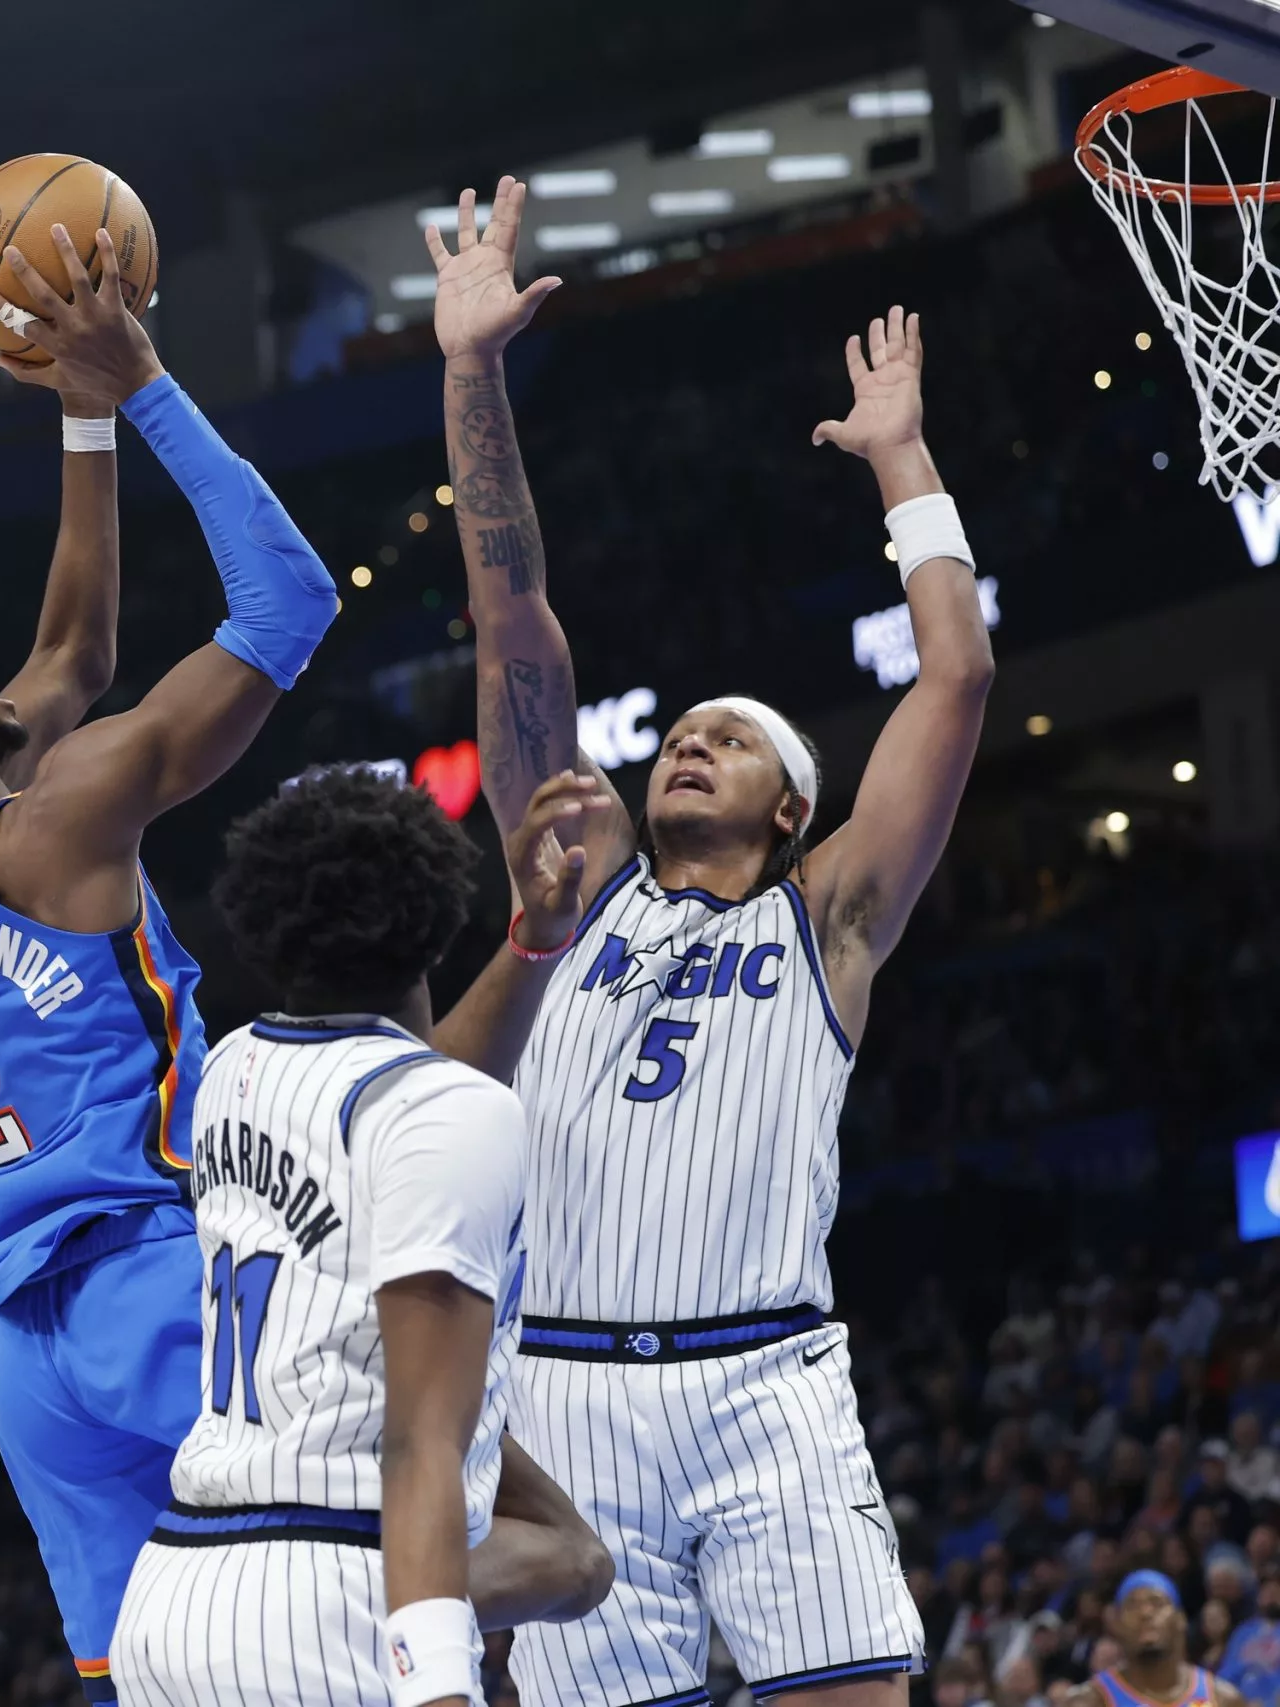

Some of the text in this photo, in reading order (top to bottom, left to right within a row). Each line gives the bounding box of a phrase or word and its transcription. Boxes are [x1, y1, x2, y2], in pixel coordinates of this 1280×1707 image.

[579, 933, 786, 1002] MGIC
[622, 1017, 700, 1103] 5
[192, 1118, 342, 1259] CHARDSON
[209, 1241, 285, 1426] 11
